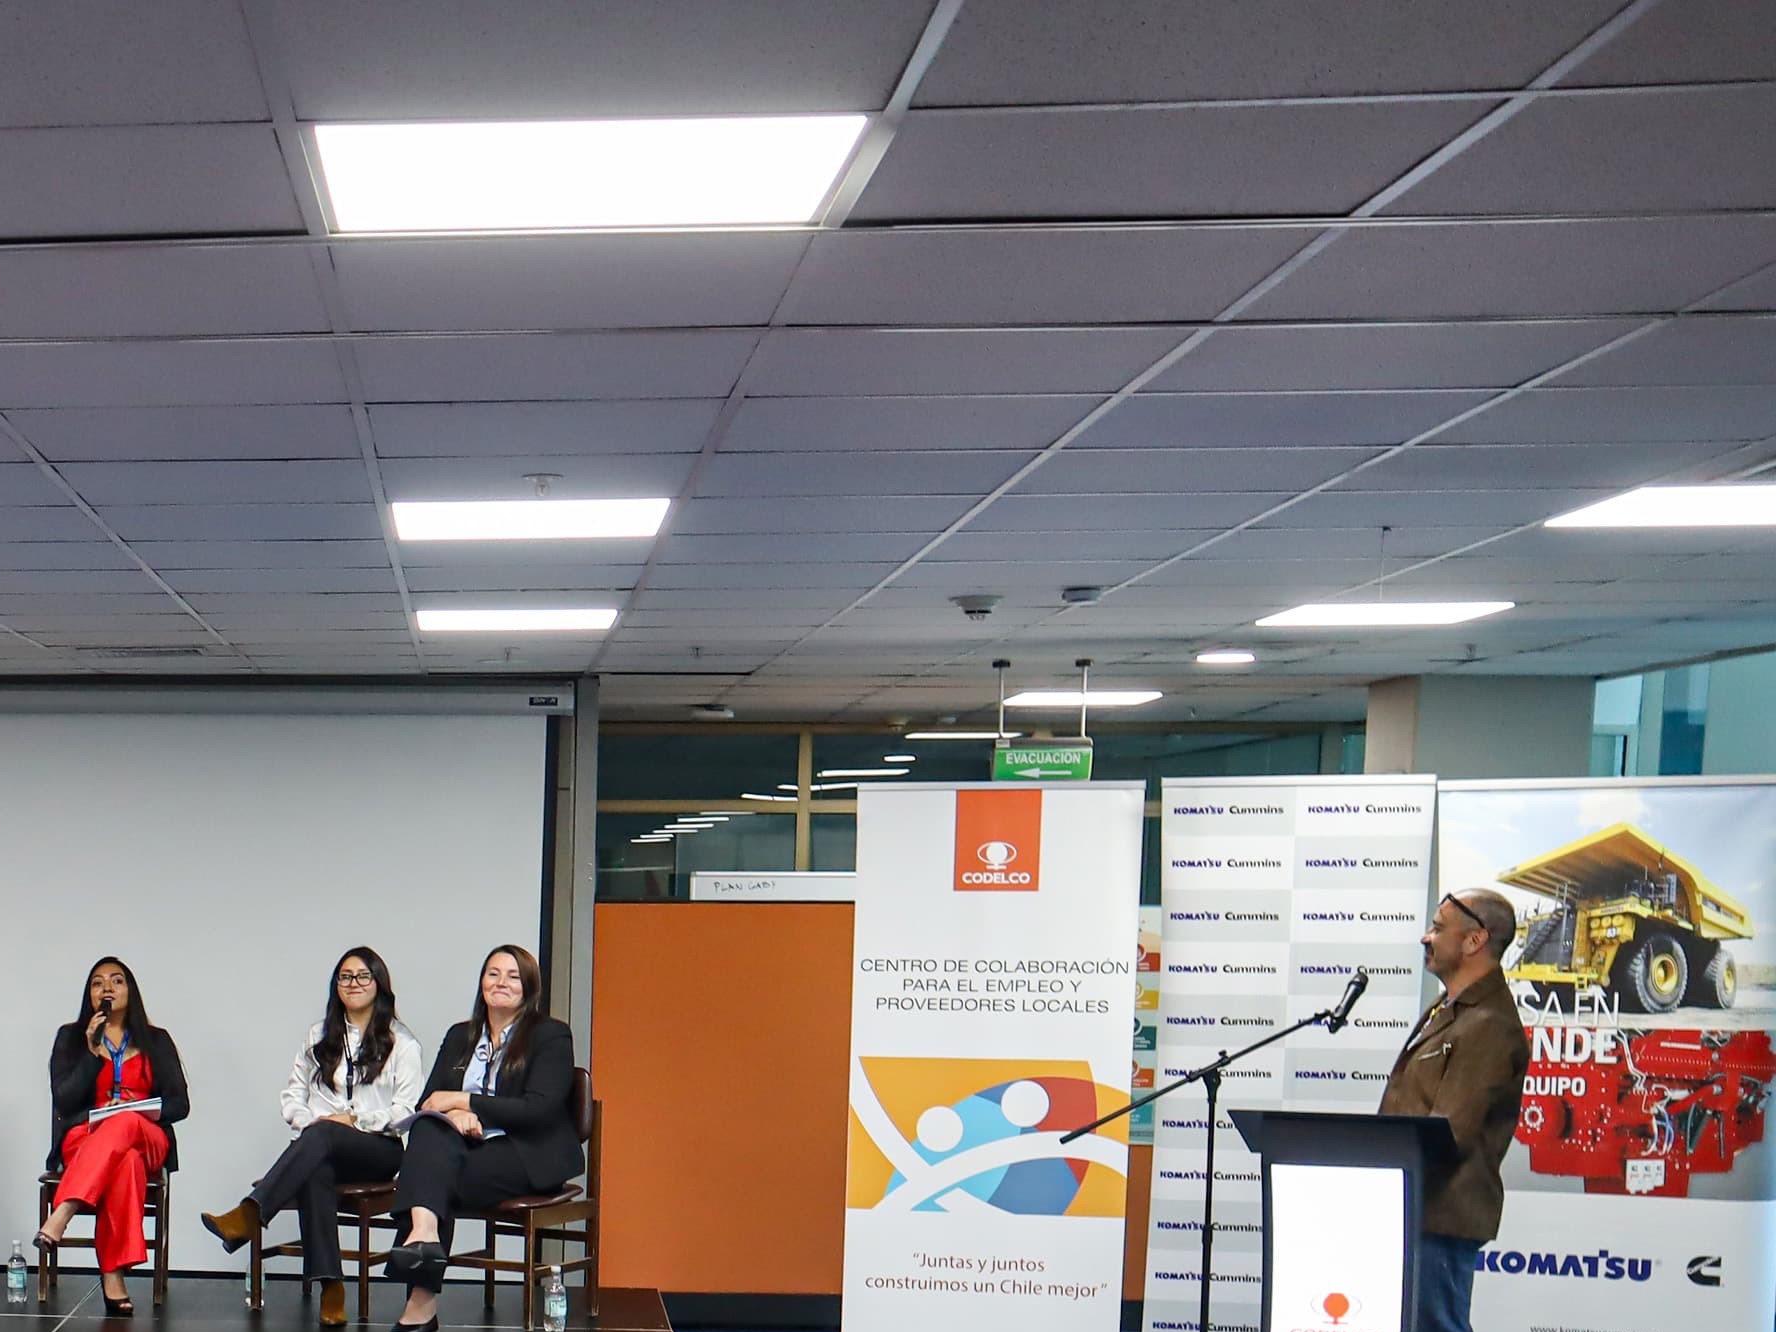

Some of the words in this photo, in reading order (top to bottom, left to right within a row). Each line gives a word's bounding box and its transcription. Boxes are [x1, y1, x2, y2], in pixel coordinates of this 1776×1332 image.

[1173, 805, 1224, 815] KOMATSU
[1229, 805, 1284, 815] Cummins
[1307, 804, 1360, 814] KOMATSU
[1365, 804, 1422, 814] Cummins
[1171, 858, 1222, 868] KOMATSU
[1227, 858, 1282, 868] Cummins
[1305, 858, 1357, 868] KOMATSU
[1362, 858, 1419, 868] Cummins
[961, 872, 1031, 885] CODELCO
[1170, 911, 1220, 921] KOMATSU
[1225, 911, 1280, 921] Cummins
[1303, 911, 1355, 921] KOMATSU
[1359, 911, 1416, 922] Cummins
[860, 959, 938, 973] CENTRO
[943, 959, 969, 973] DE
[974, 957, 1129, 974] COLABORACIÓN
[1168, 963, 1218, 973] KOMATSU
[1222, 964, 1277, 974] Cummins
[1300, 964, 1352, 975] KOMATSU
[1356, 965, 1413, 975] Cummins
[902, 978, 951, 992] PARA
[957, 979, 979, 992] EL
[985, 979, 1064, 993] EMPLEO
[1070, 980, 1083, 993] Y
[875, 997, 1016, 1012] PROVEEDORES
[1022, 999, 1110, 1013] LOCALES
[1516, 991, 1566, 1026] SA
[1574, 991, 1620, 1026] EN
[1166, 1015, 1216, 1025] KOMATSU
[1220, 1016, 1275, 1026] Cummins
[1354, 1018, 1409, 1028] Cummins
[1532, 1026, 1618, 1064] NDE
[1219, 1068, 1272, 1078] Cummins
[1295, 1070, 1346, 1080] KOMATSU
[1351, 1071, 1391, 1080] Cumm
[1522, 1075, 1587, 1096] QUIPO
[1213, 1172, 1261, 1181] Cummin
[978, 1258, 988, 1273] y
[990, 1256, 1045, 1274] juntos
[1474, 1249, 1653, 1282] KOMATSU
[1155, 1271, 1203, 1280] KOMATSU
[1209, 1273, 1261, 1283] Cummins
[865, 1276, 969, 1293] construimos
[974, 1282, 995, 1294] un
[1000, 1280, 1043, 1296] Chile
[1152, 1321, 1201, 1331] KOMATSU
[1207, 1323, 1259, 1332] Cummins
